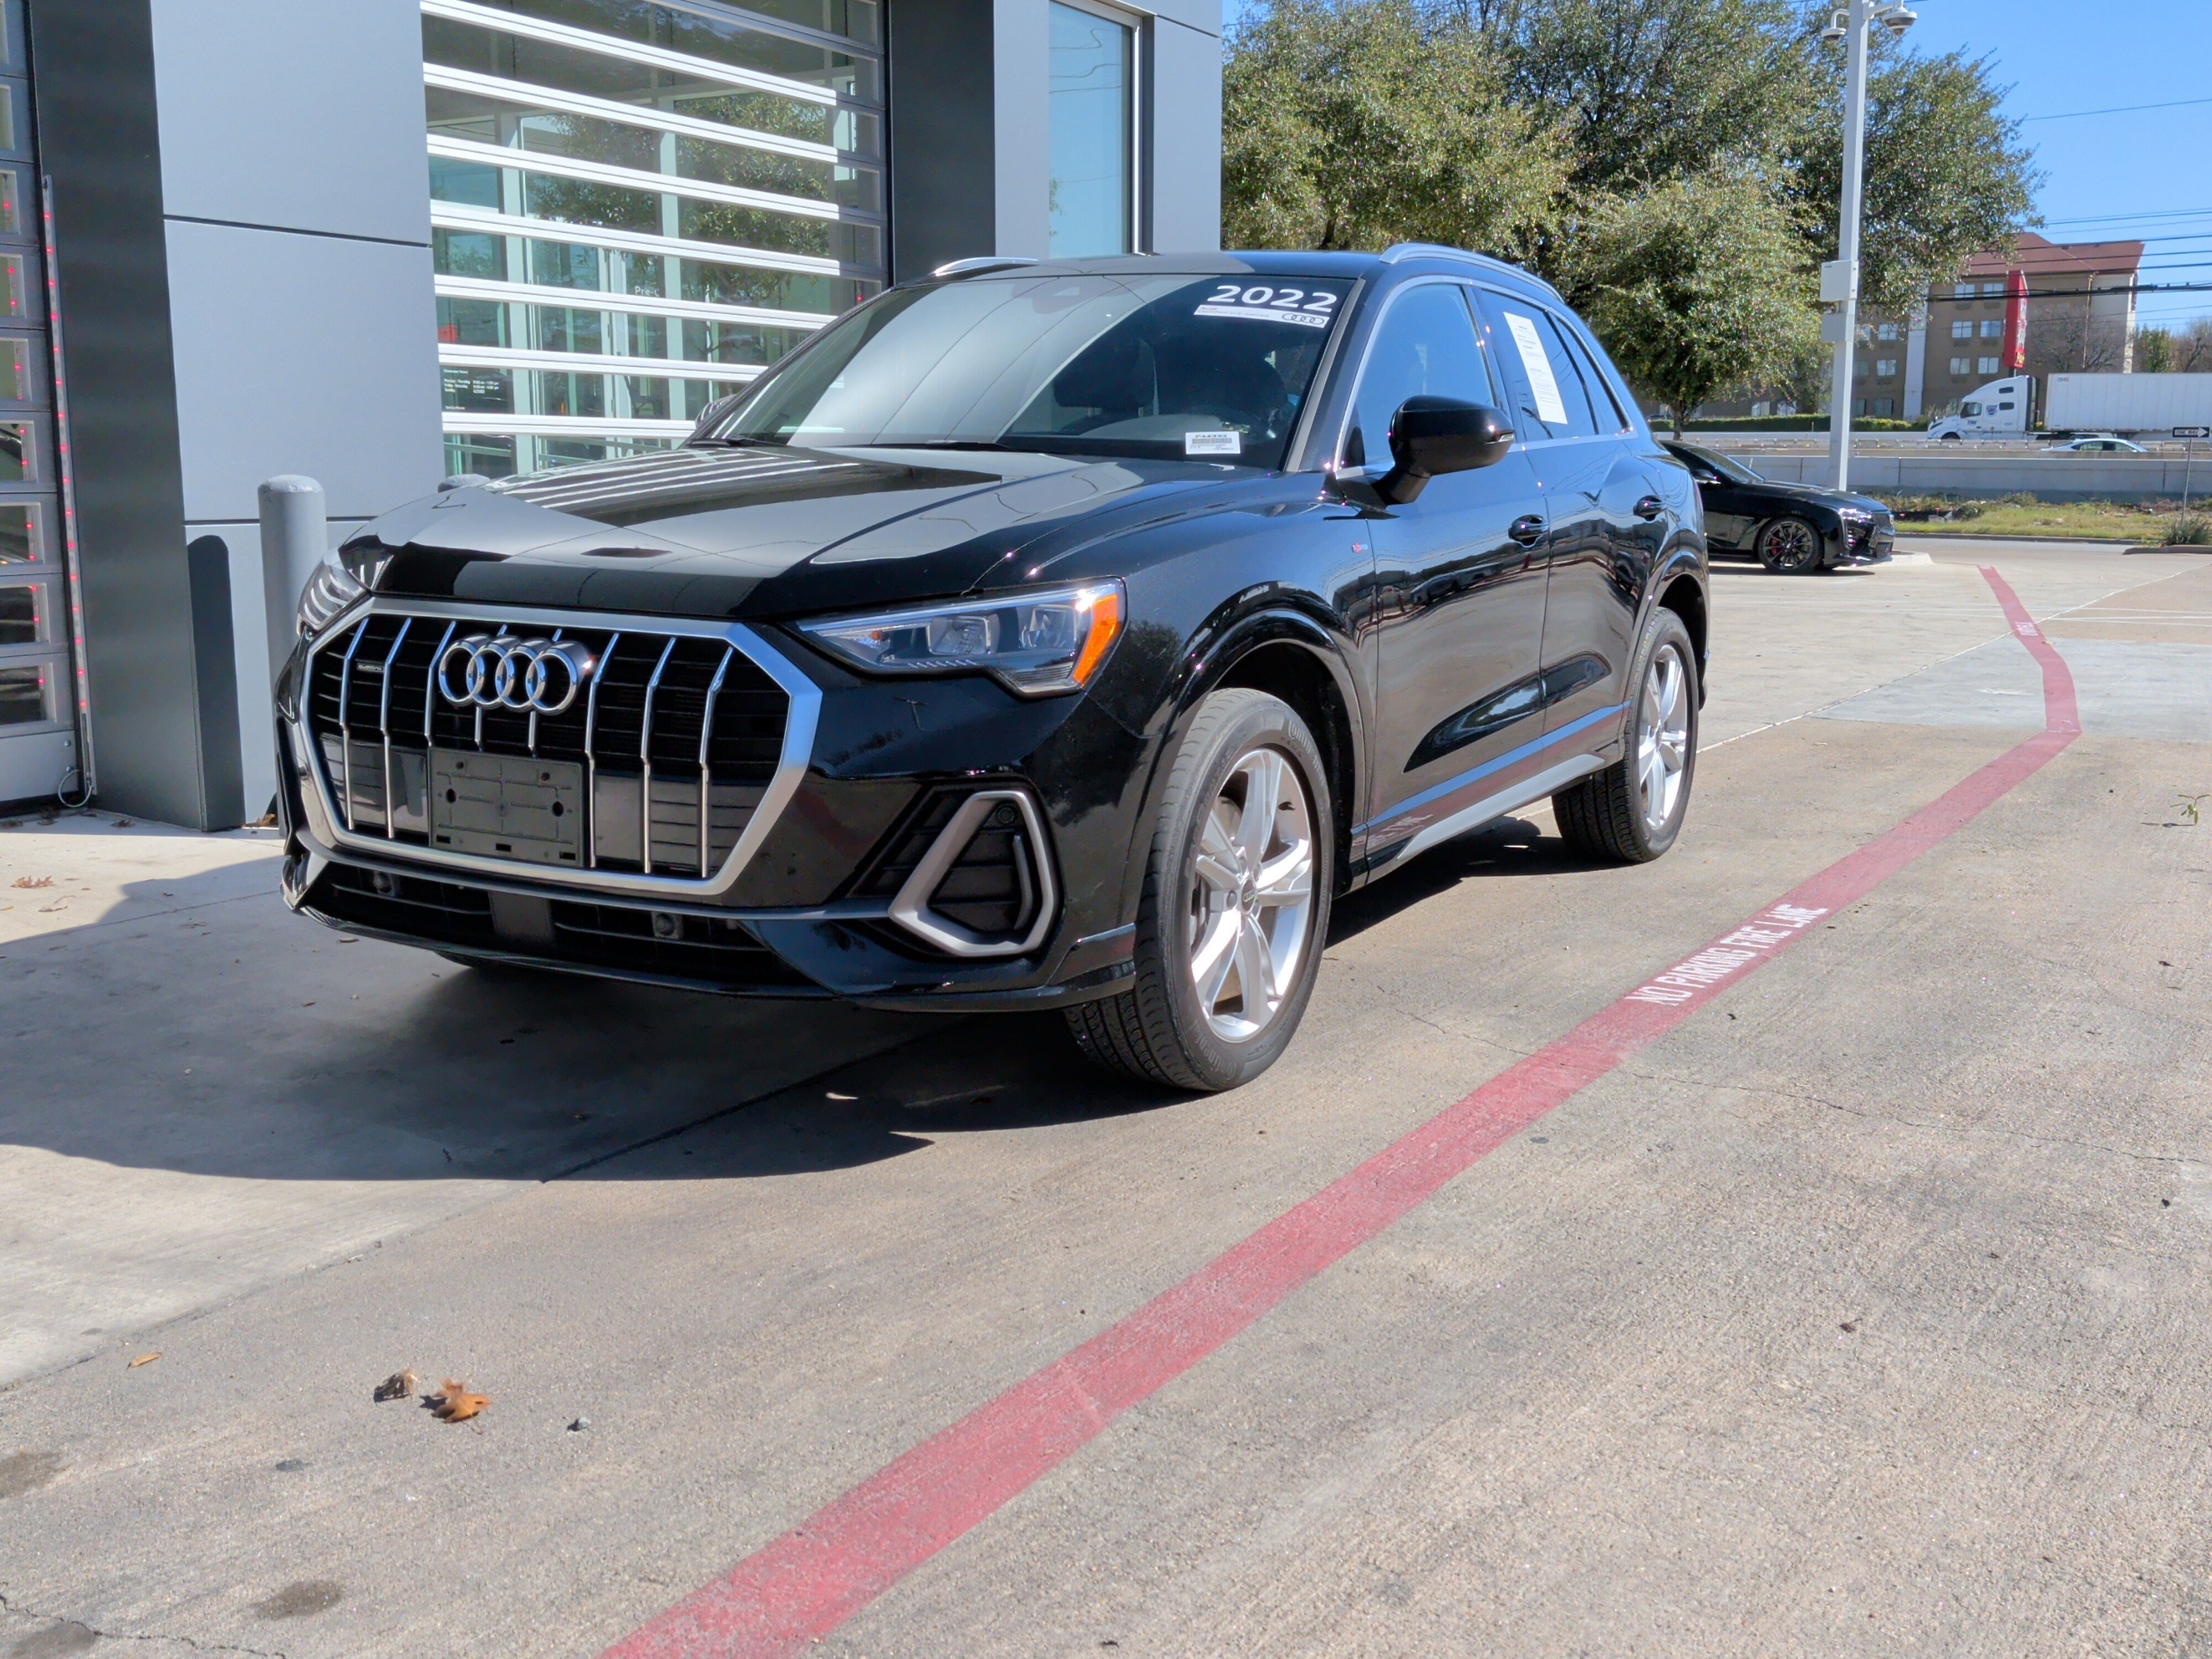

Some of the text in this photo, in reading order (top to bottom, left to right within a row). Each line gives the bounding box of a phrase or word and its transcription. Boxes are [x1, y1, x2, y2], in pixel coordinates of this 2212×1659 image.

[1207, 285, 1337, 313] 2022
[1624, 904, 1828, 1006] NO PARKING FIRE LANE
